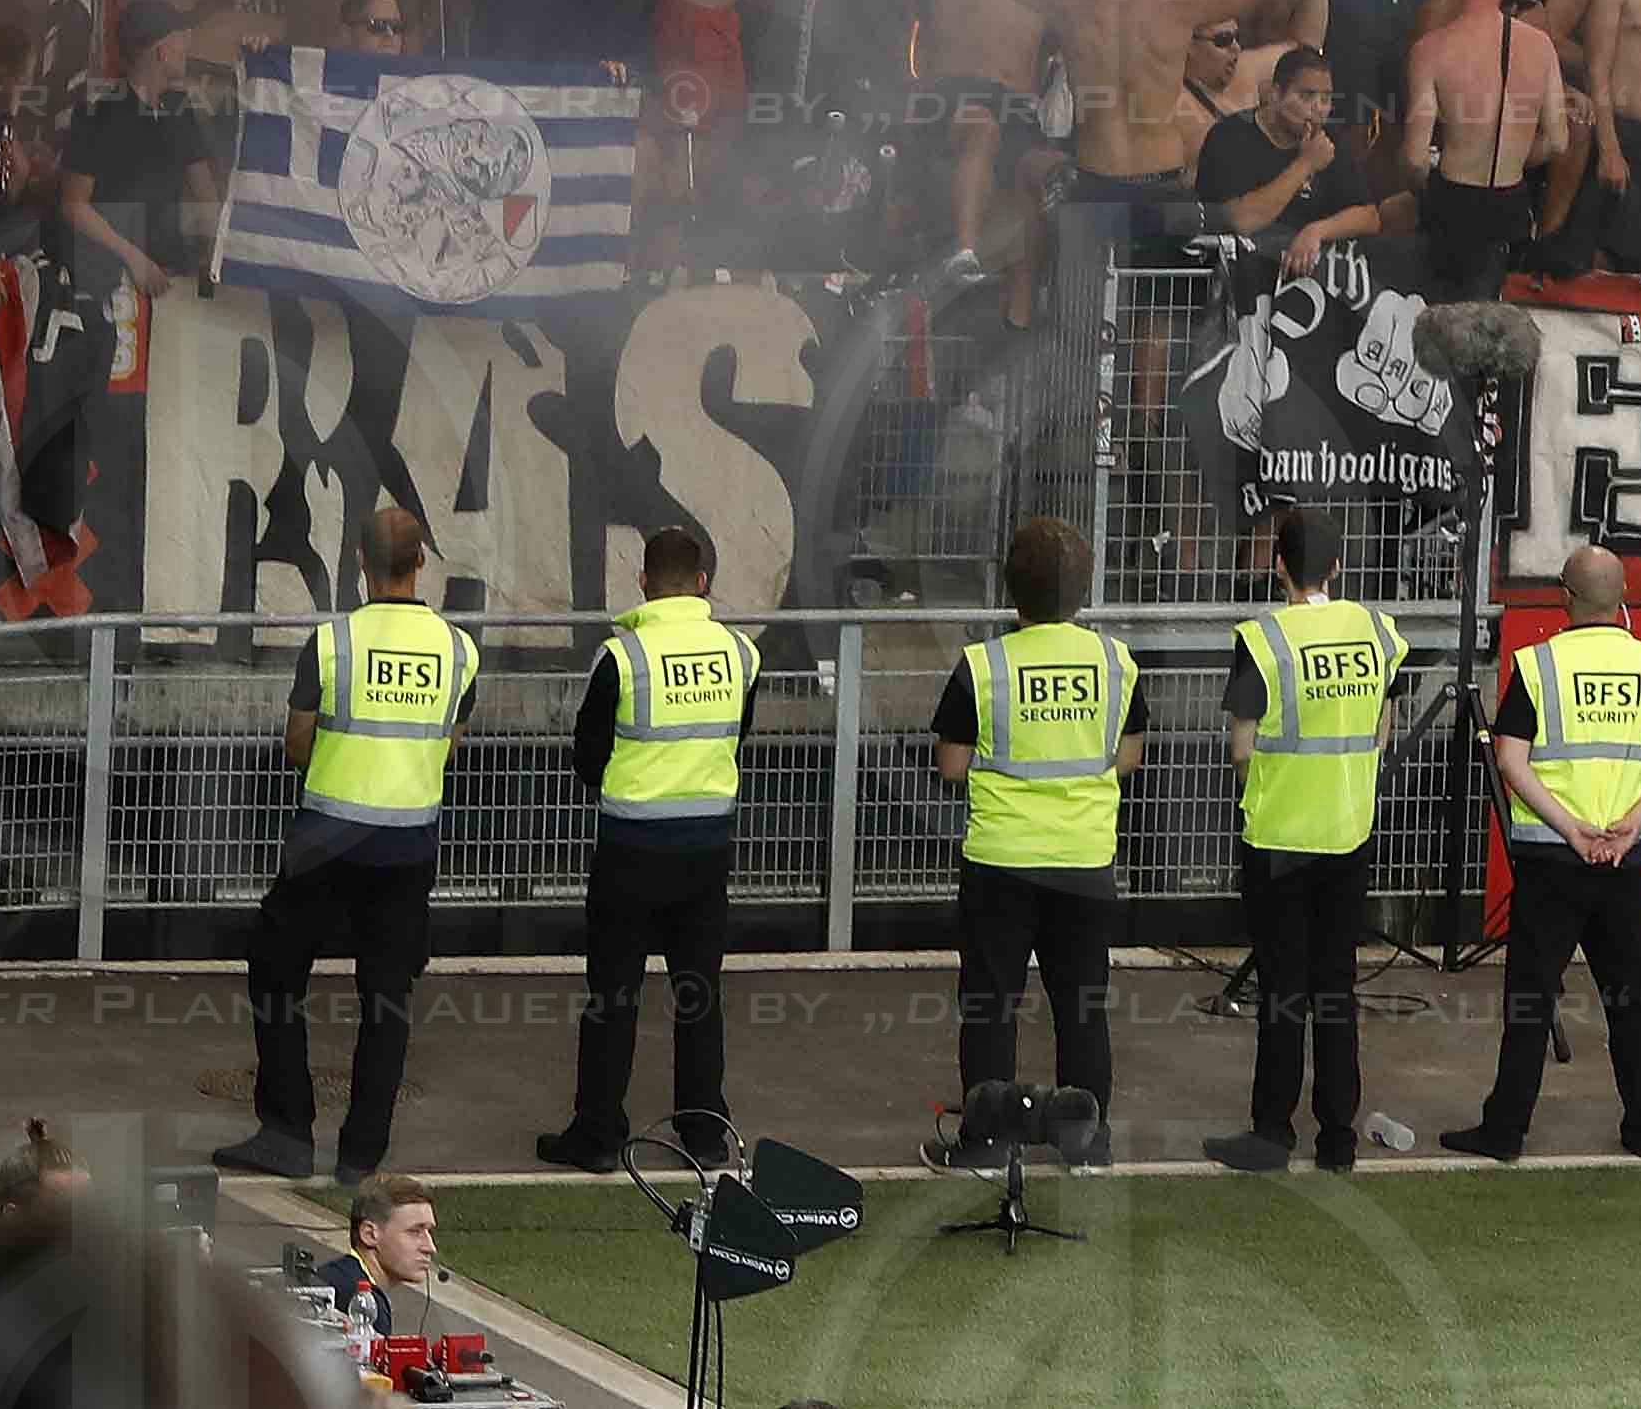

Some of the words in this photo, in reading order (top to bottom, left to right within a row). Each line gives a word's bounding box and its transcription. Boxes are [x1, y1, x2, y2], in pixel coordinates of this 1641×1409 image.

[377, 660, 441, 688] BFS
[673, 661, 725, 687] BFS
[1313, 651, 1373, 680] BFS
[366, 690, 439, 705] SECURITY
[666, 688, 732, 705] SECURITY
[1029, 676, 1088, 702] BFS
[1305, 682, 1378, 699] SECURITY
[1583, 682, 1630, 706] BFS
[1020, 707, 1097, 722] SECURITY
[1577, 710, 1638, 724] SECURITY
